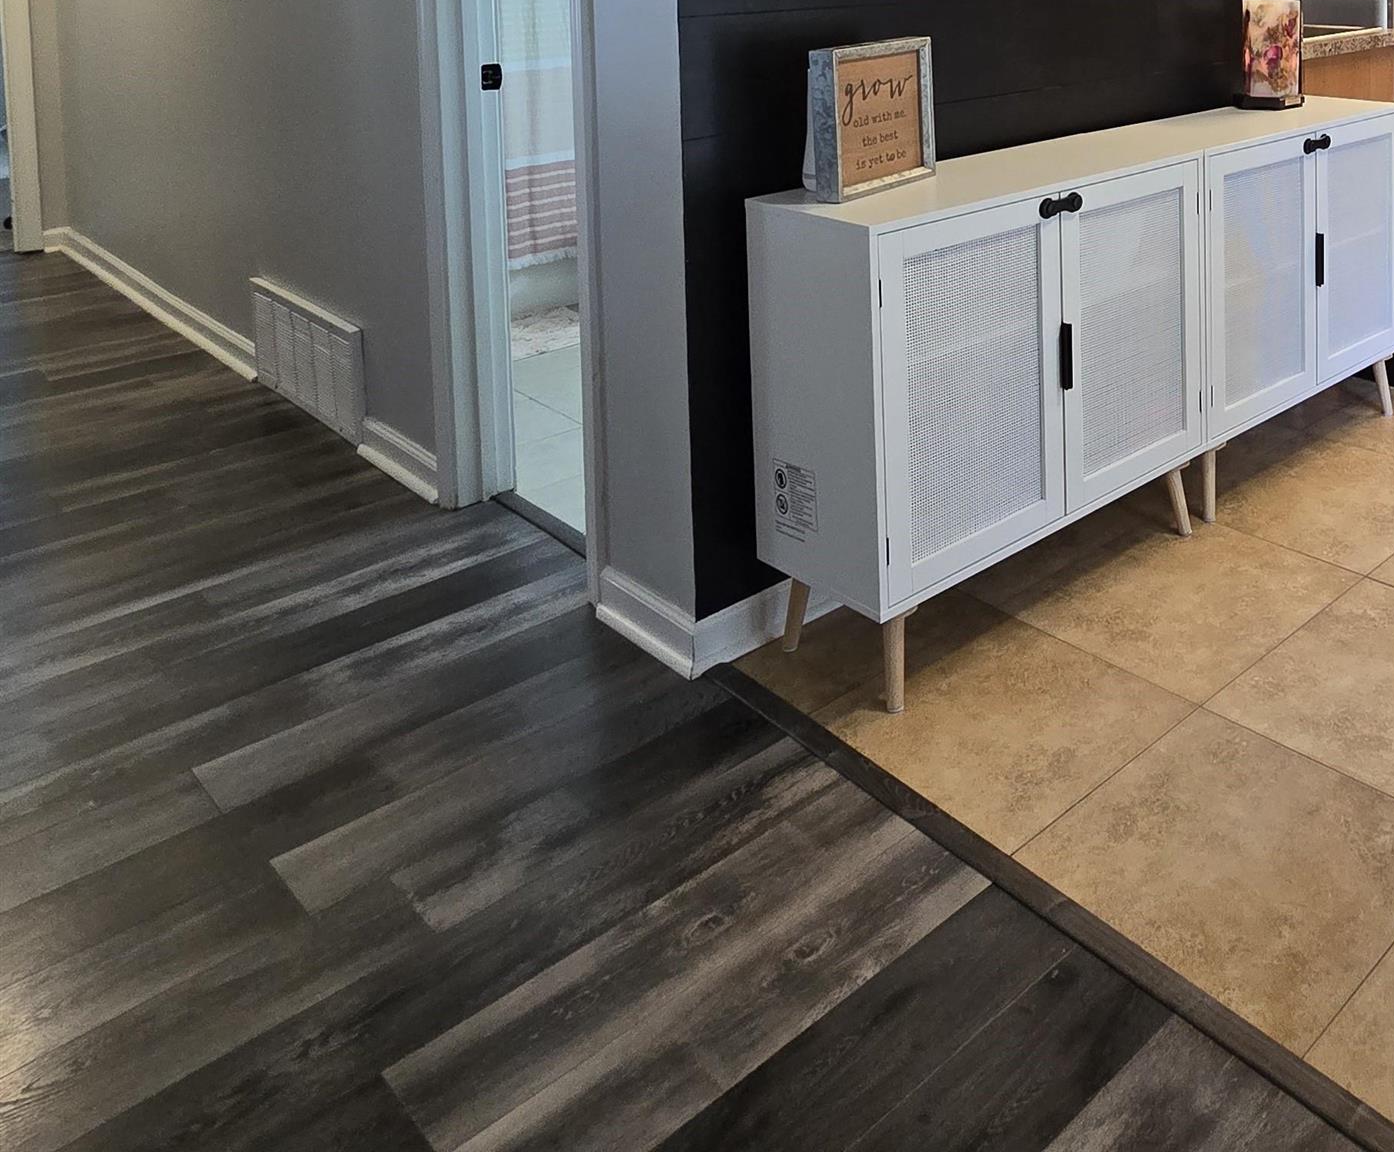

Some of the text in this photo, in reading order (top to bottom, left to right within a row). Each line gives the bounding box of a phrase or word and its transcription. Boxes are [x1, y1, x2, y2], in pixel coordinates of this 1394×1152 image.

[841, 74, 913, 127] grow
[853, 114, 869, 128] old
[871, 111, 892, 124] with
[862, 130, 898, 147] the best
[856, 149, 907, 170] is yet to be
